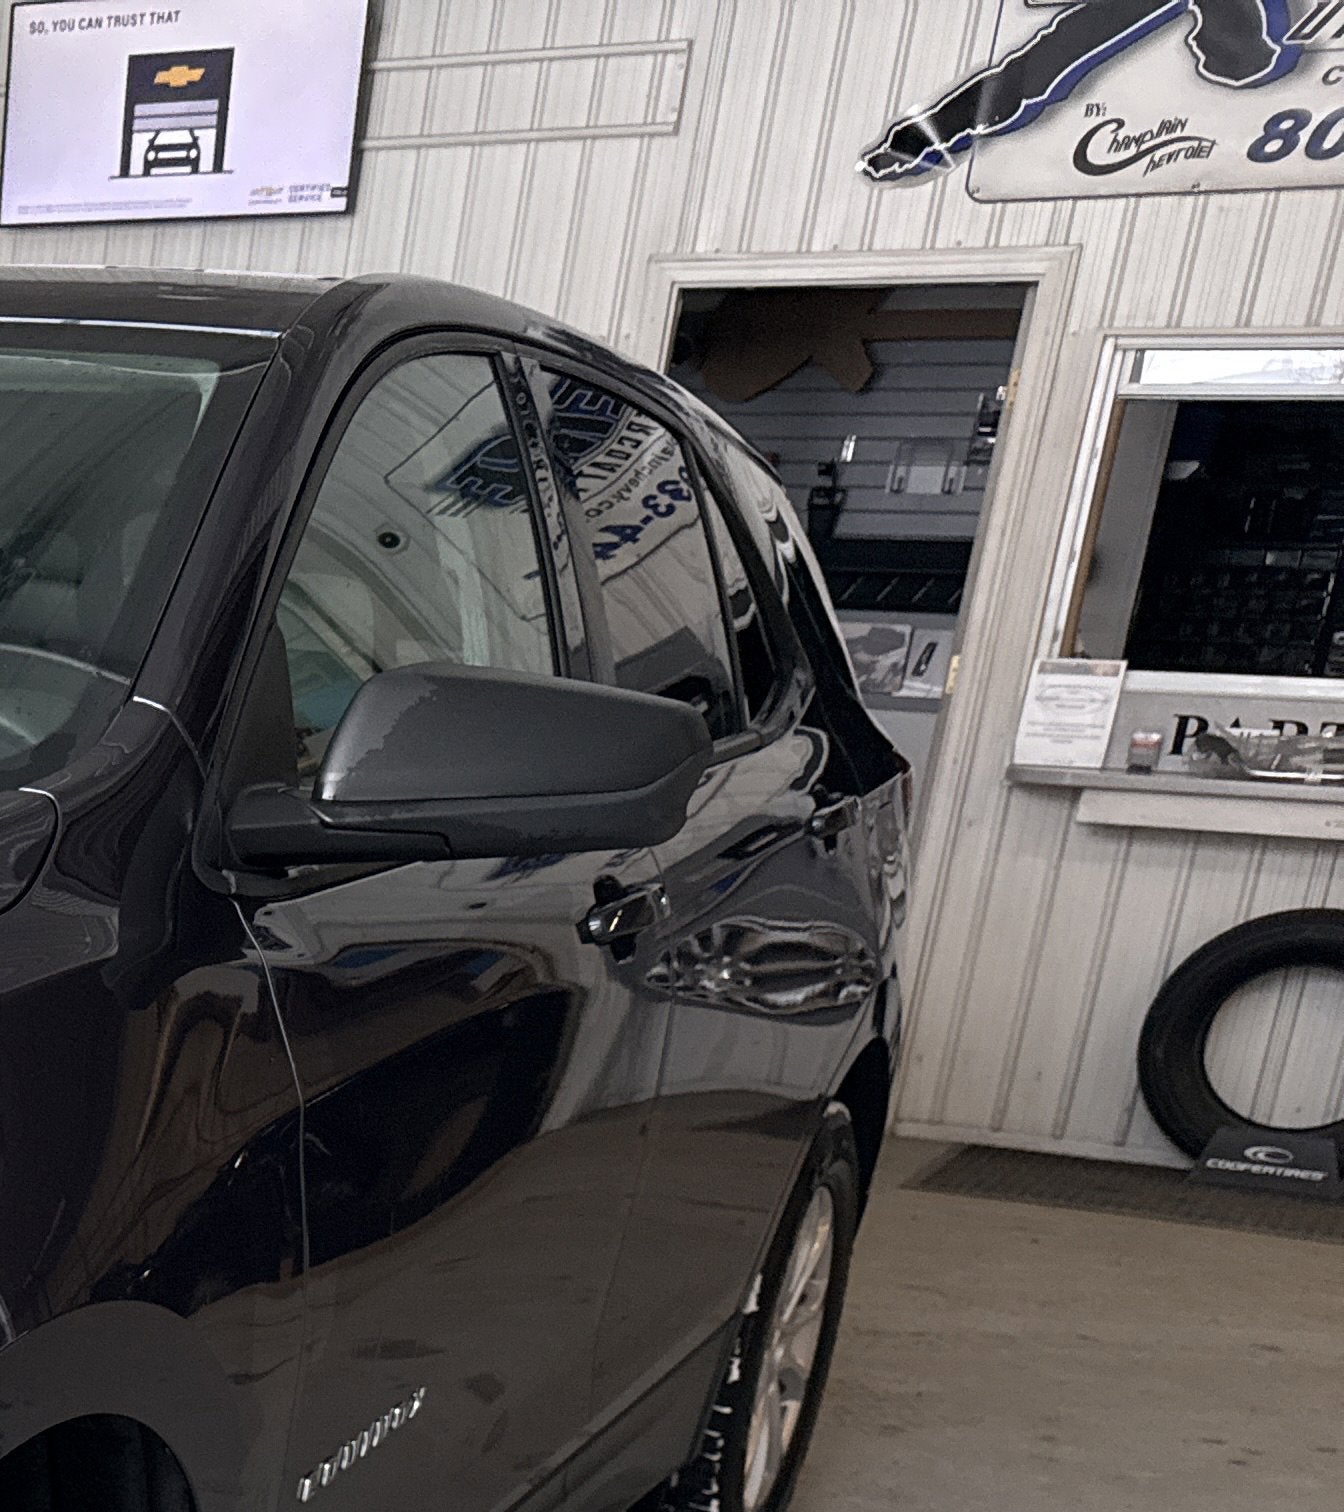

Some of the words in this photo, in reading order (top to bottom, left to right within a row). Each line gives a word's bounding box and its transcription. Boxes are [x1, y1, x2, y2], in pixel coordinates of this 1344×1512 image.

[52, 17, 75, 33] YOU
[78, 15, 103, 31] CAN
[106, 12, 146, 29] TRUST
[149, 10, 181, 26] THAT
